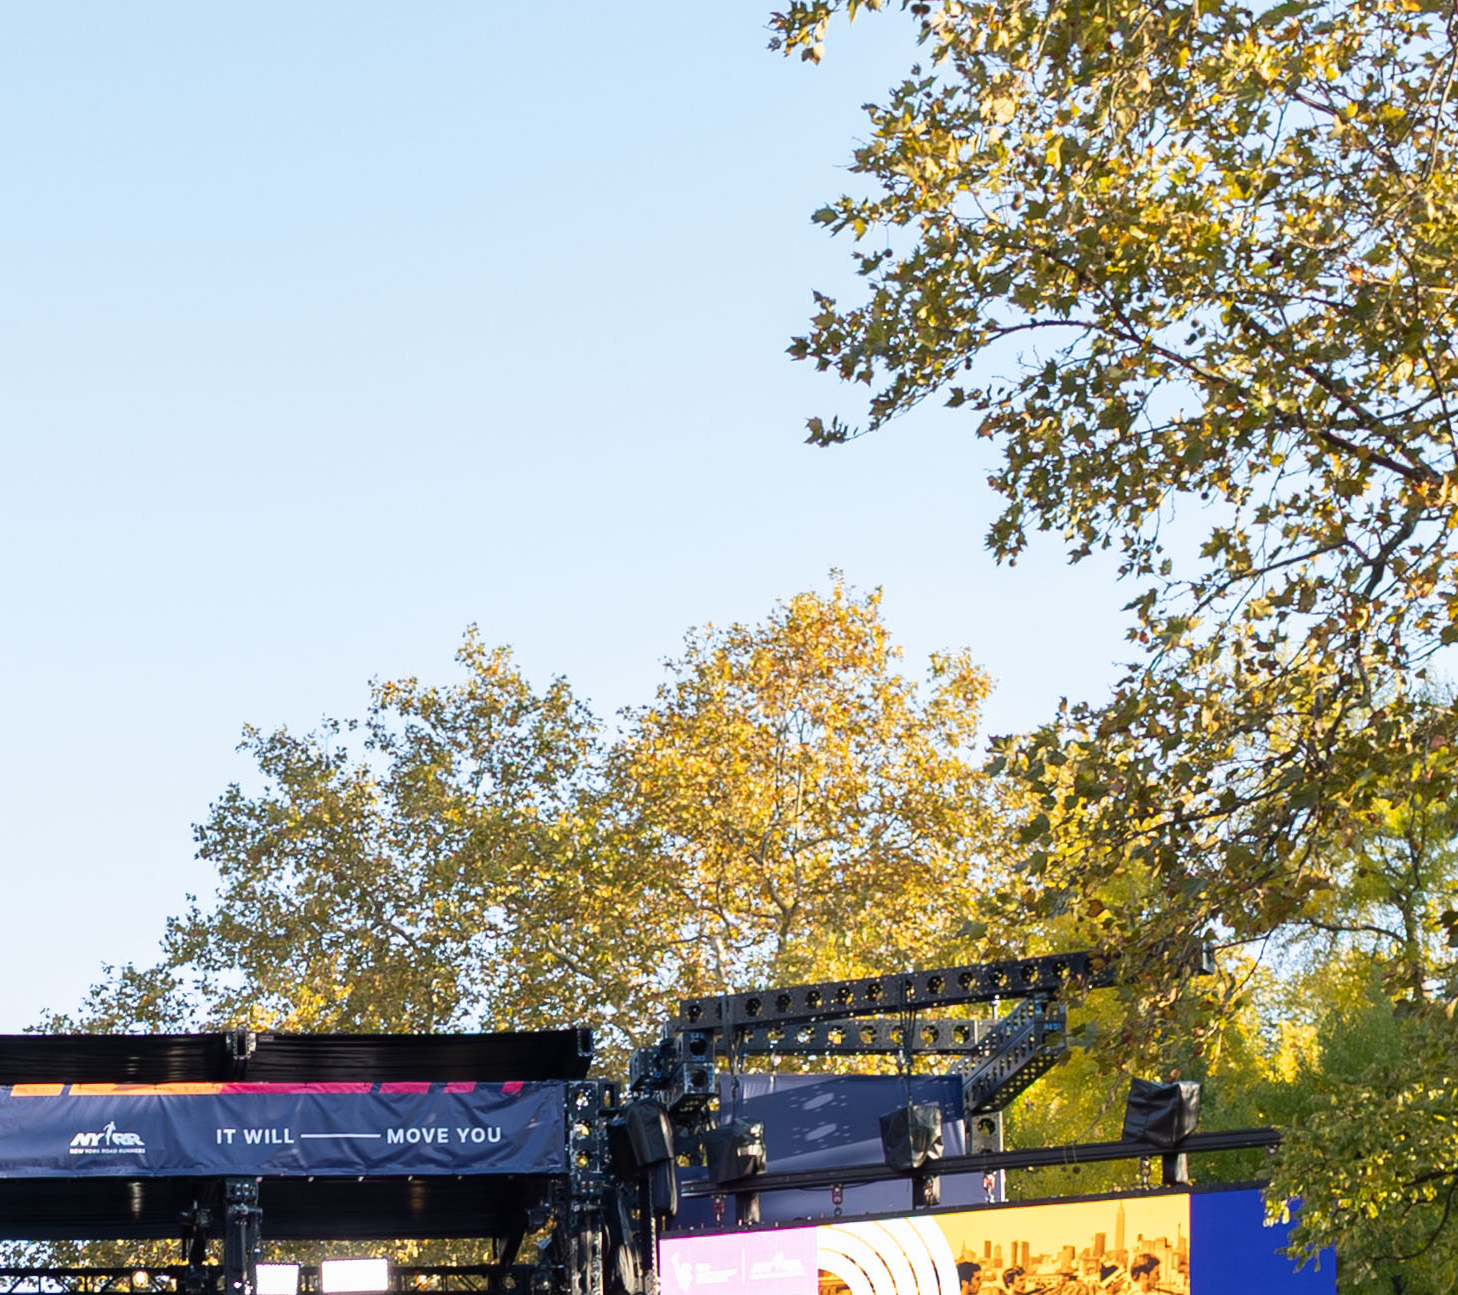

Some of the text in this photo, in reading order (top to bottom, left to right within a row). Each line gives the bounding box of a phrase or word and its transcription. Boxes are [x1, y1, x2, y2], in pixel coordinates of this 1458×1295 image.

[216, 1126, 502, 1145] IT WILL MOVE YOU
